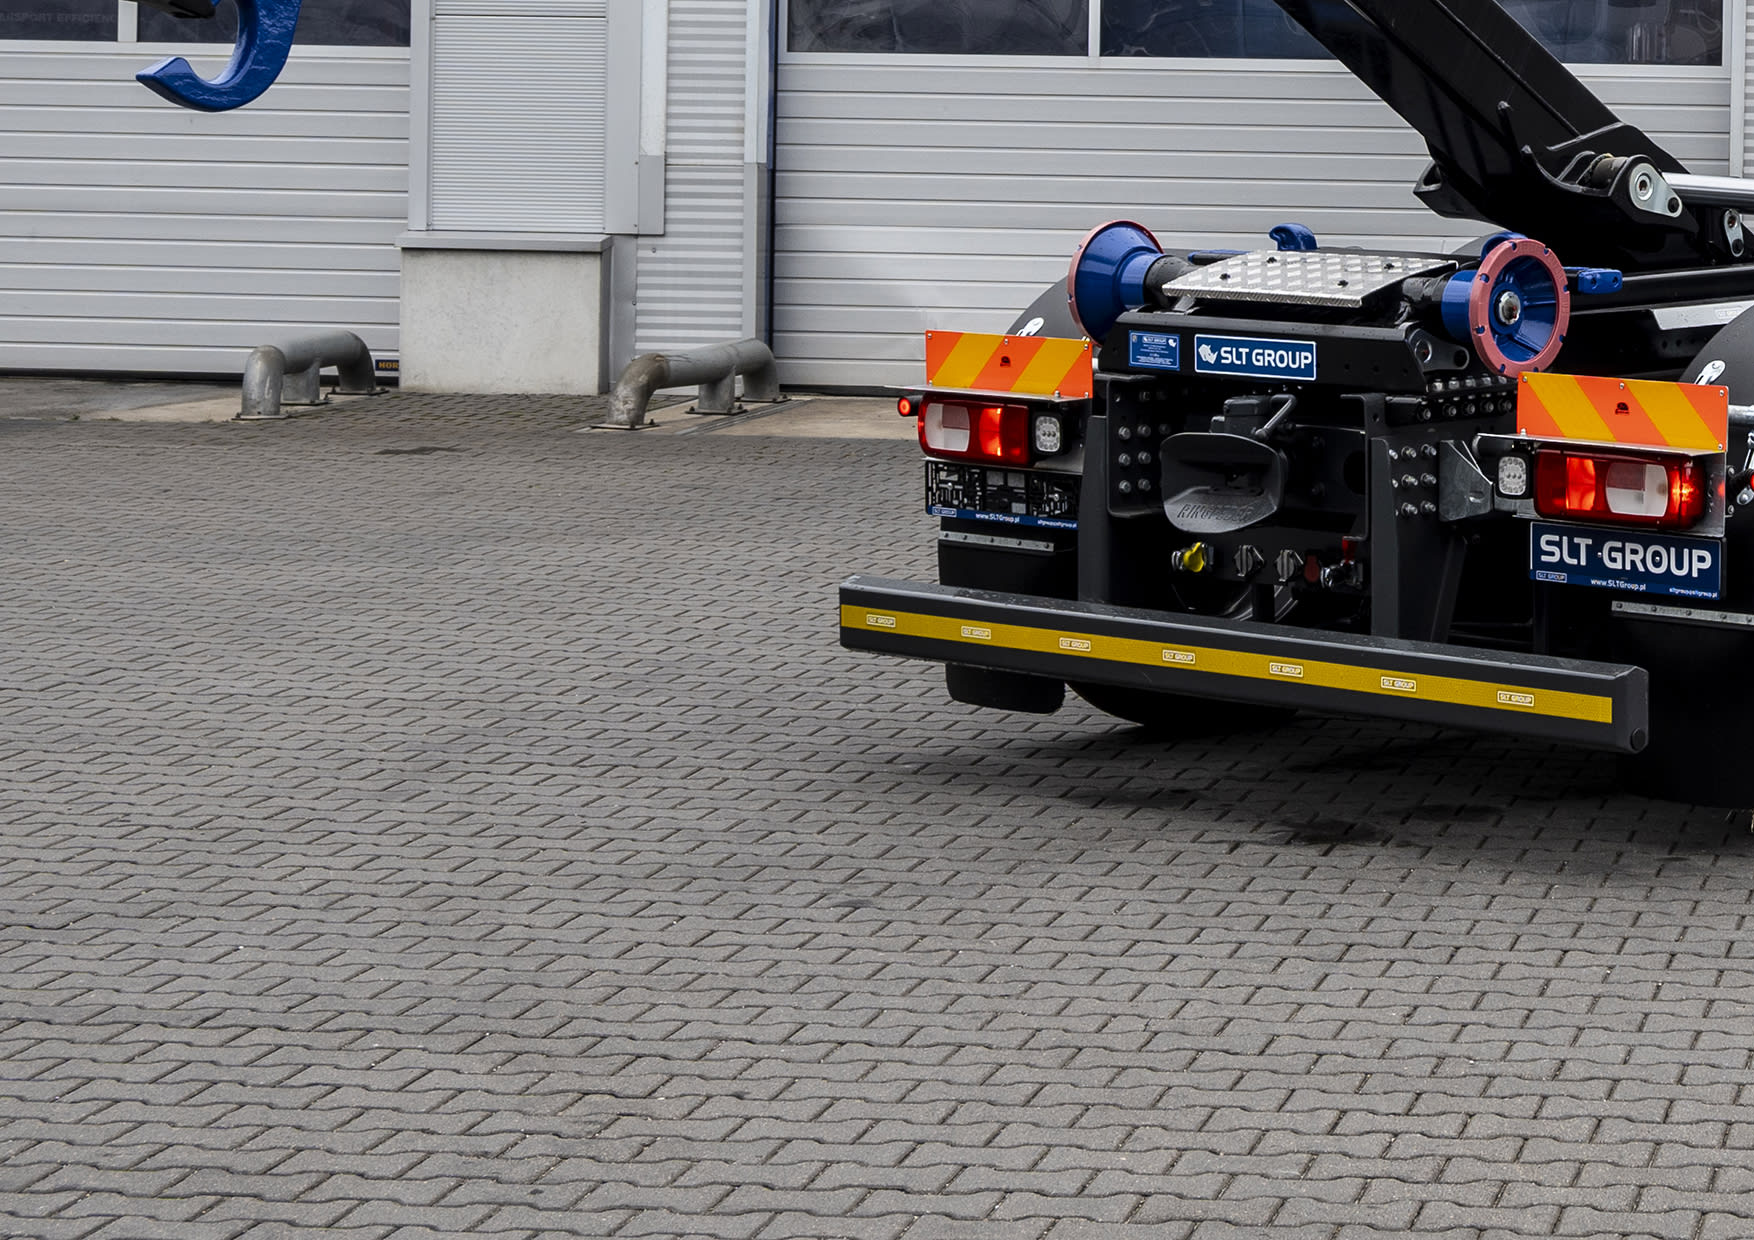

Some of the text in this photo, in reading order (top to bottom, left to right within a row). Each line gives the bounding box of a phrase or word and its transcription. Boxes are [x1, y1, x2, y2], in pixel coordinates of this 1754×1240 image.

[1220, 347, 1312, 369] SLT GROUP
[1540, 534, 1712, 578] SLT GROUP
[1590, 579, 1646, 591] www.SLTGroup.pl
